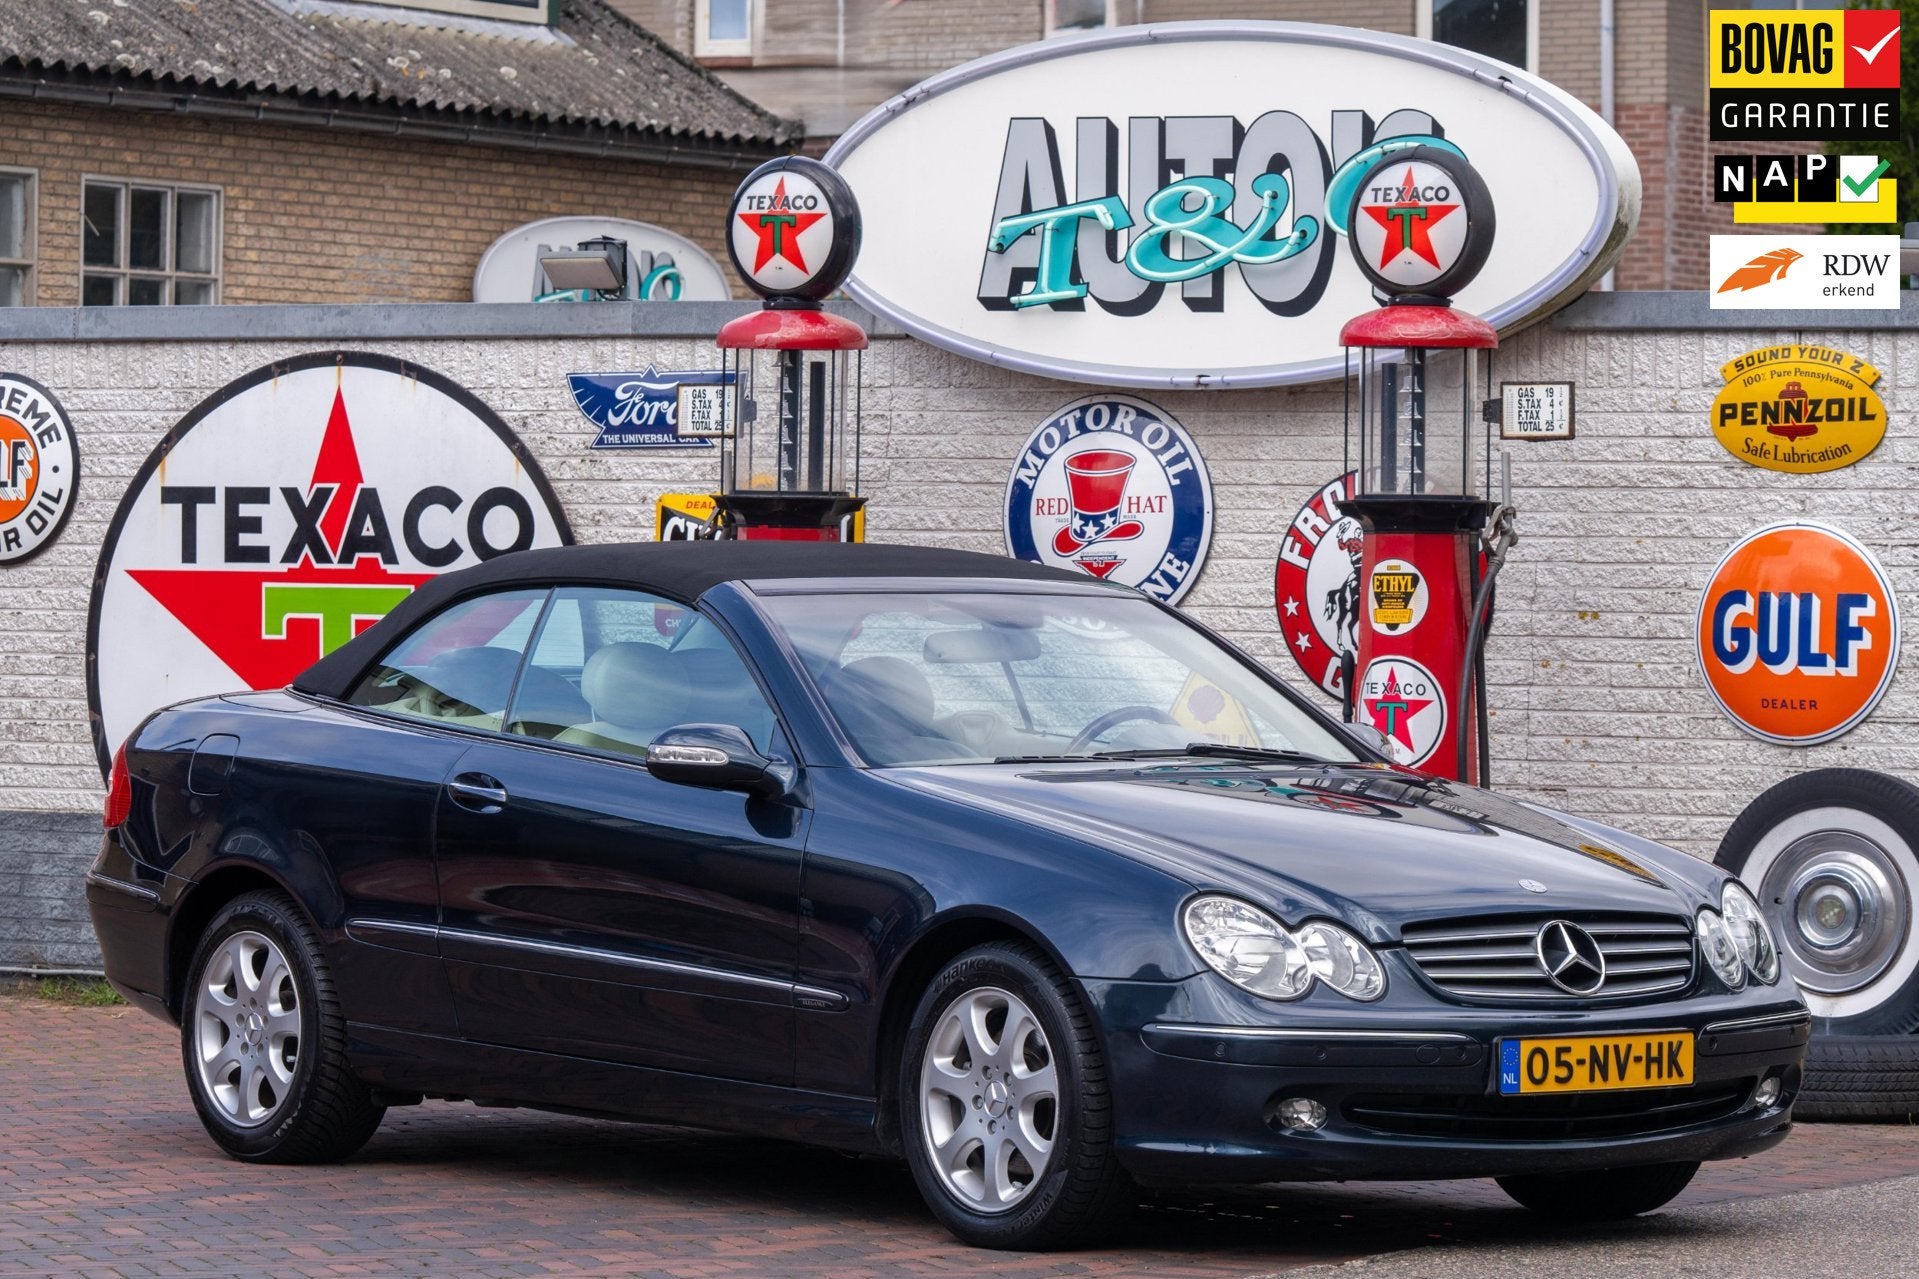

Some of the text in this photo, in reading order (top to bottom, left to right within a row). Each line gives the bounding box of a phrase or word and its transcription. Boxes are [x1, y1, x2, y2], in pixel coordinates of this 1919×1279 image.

[747, 195, 818, 210] TEXACO
[1371, 186, 1450, 203] TEXACO
[977, 109, 1445, 318] AUTO'
[1734, 346, 1866, 374] SOUND YOUR Z
[1770, 369, 1792, 380] Pure
[1794, 368, 1854, 391] Pennsylvania
[692, 389, 707, 399] GAS
[1518, 387, 1535, 398] GAS
[1545, 387, 1554, 398] 19
[691, 400, 712, 410] S.TAX
[1518, 399, 1542, 409] S.TAX
[1549, 399, 1554, 409] 4
[1719, 396, 1877, 427] PENNZOIL
[691, 410, 711, 420] F.TAX
[1518, 410, 1541, 420] F.TAX
[1550, 410, 1554, 420] 1
[691, 421, 712, 431] TOTAL
[1518, 421, 1543, 432] TOTAL
[1545, 421, 1555, 432] 25
[602, 434, 620, 444] THE
[622, 433, 676, 443] UNIVERSAL
[1016, 404, 1194, 490] MOTOR OIL
[1742, 437, 1852, 464] Safe Lubrication
[25, 487, 64, 536] OIL
[686, 500, 716, 509] DEAL
[1035, 495, 1167, 516] RED HAT
[161, 485, 535, 566] TEXACO
[1280, 472, 1359, 571] FRO
[1373, 575, 1415, 592] ETHYL
[1712, 589, 1876, 677] GULF
[1366, 682, 1426, 696] TEXACO
[1761, 698, 1818, 710] DEALER
[1503, 1040, 1685, 1086] NL 05-NV-HK
